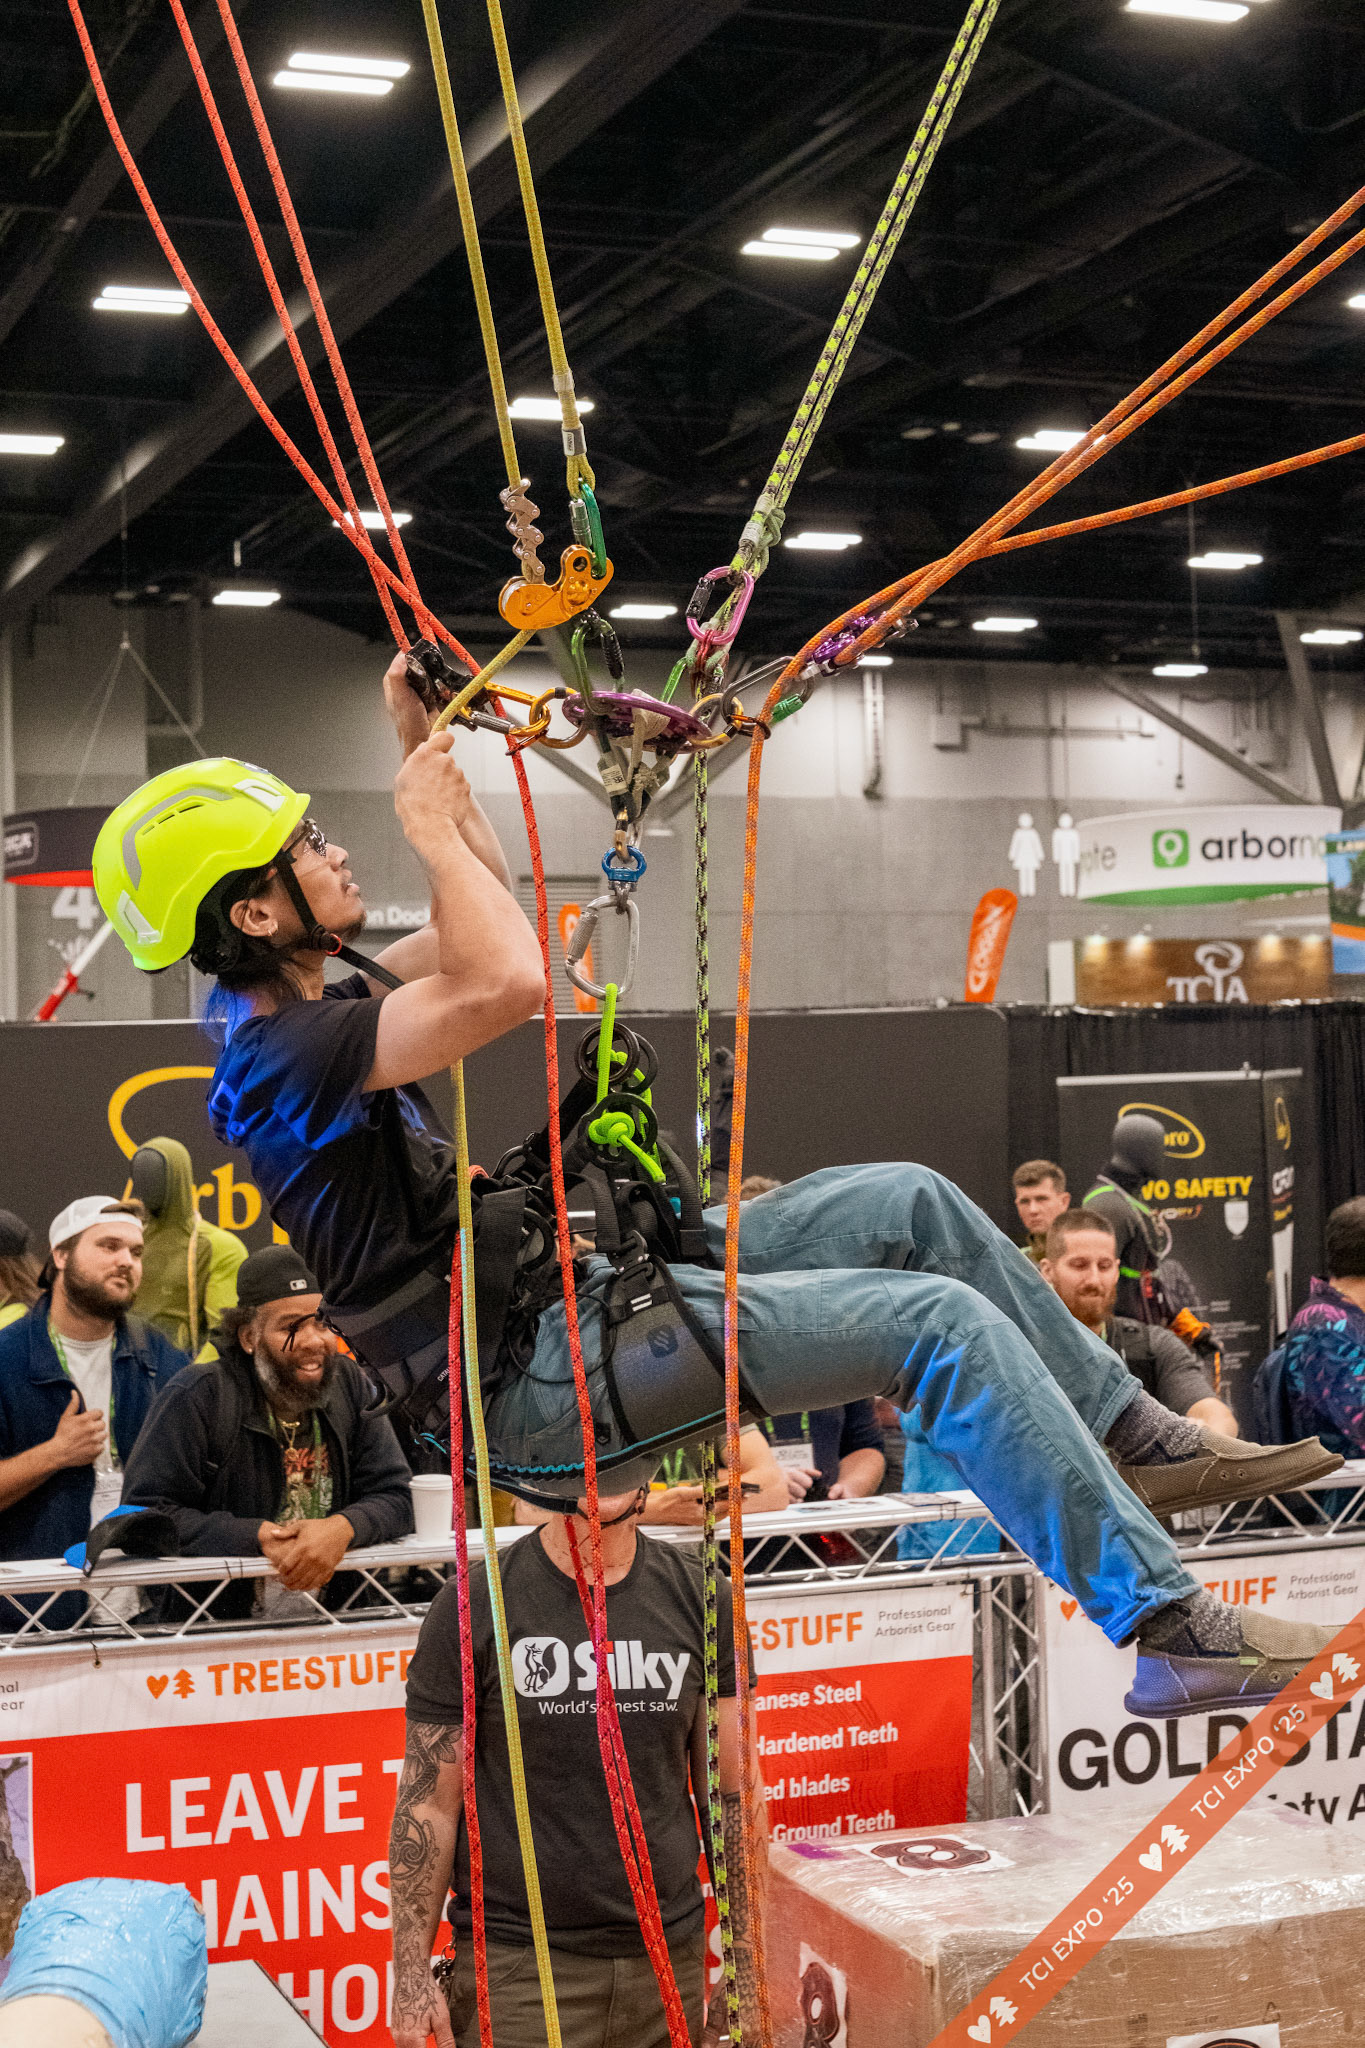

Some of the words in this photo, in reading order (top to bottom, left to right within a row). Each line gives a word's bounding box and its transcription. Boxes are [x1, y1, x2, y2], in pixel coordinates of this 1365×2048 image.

[1174, 1176, 1253, 1199] SAFETY
[1290, 1570, 1356, 1585] Professional
[1204, 1576, 1277, 1606] TUFF
[1287, 1586, 1330, 1600] Arborist
[1333, 1585, 1358, 1596] Gear
[878, 1605, 951, 1621] Professional
[875, 1622, 923, 1638] Arborist
[926, 1621, 957, 1633] Gear
[0, 1701, 25, 1711] ear
[538, 1701, 597, 1715] World's
[649, 1700, 679, 1712] saw.
[755, 1690, 810, 1712] anese
[813, 1680, 862, 1705] Steel
[847, 1722, 899, 1747] Teeth
[1058, 1713, 1254, 1791] GOLD
[764, 1778, 785, 1801] ed
[789, 1773, 850, 1798] blades
[125, 1762, 365, 1853] LEAVE
[768, 1816, 842, 1843] -Ground
[845, 1809, 896, 1835] Teeth
